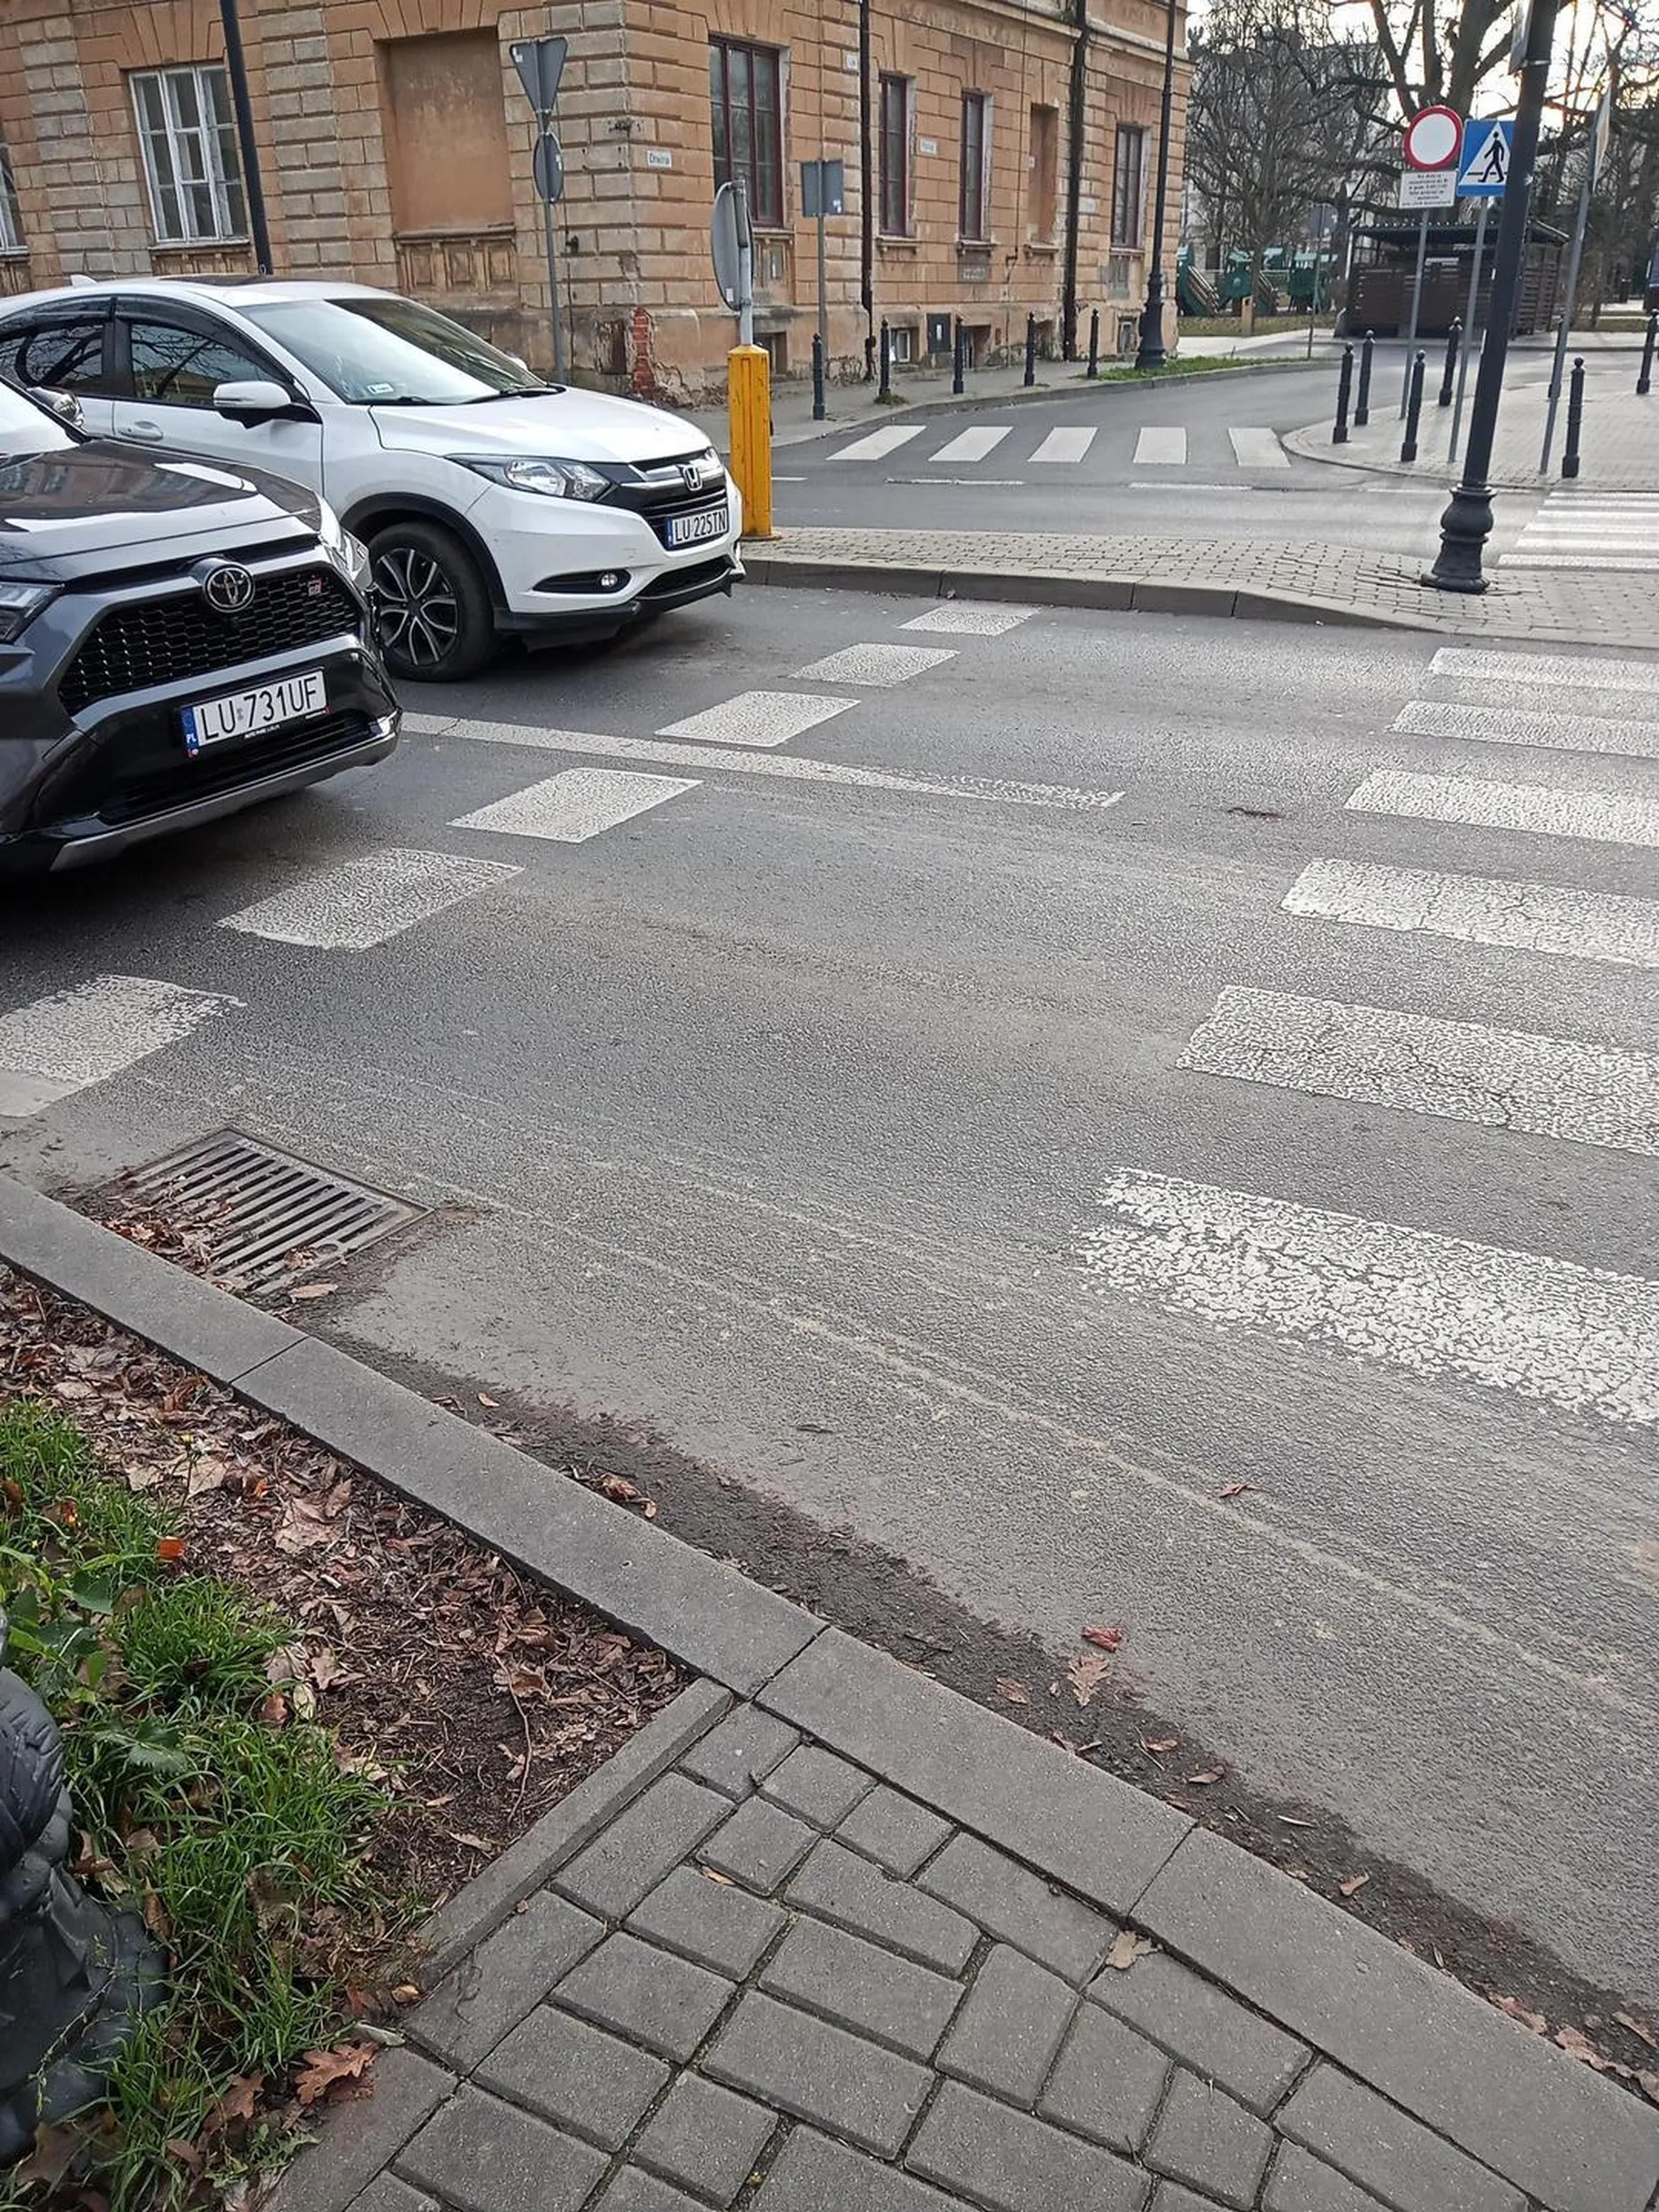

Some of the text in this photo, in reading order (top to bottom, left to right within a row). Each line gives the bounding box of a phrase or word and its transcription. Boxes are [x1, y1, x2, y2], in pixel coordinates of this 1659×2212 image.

[675, 510, 726, 541] LU 225TN
[201, 676, 317, 741] LU 731UF
